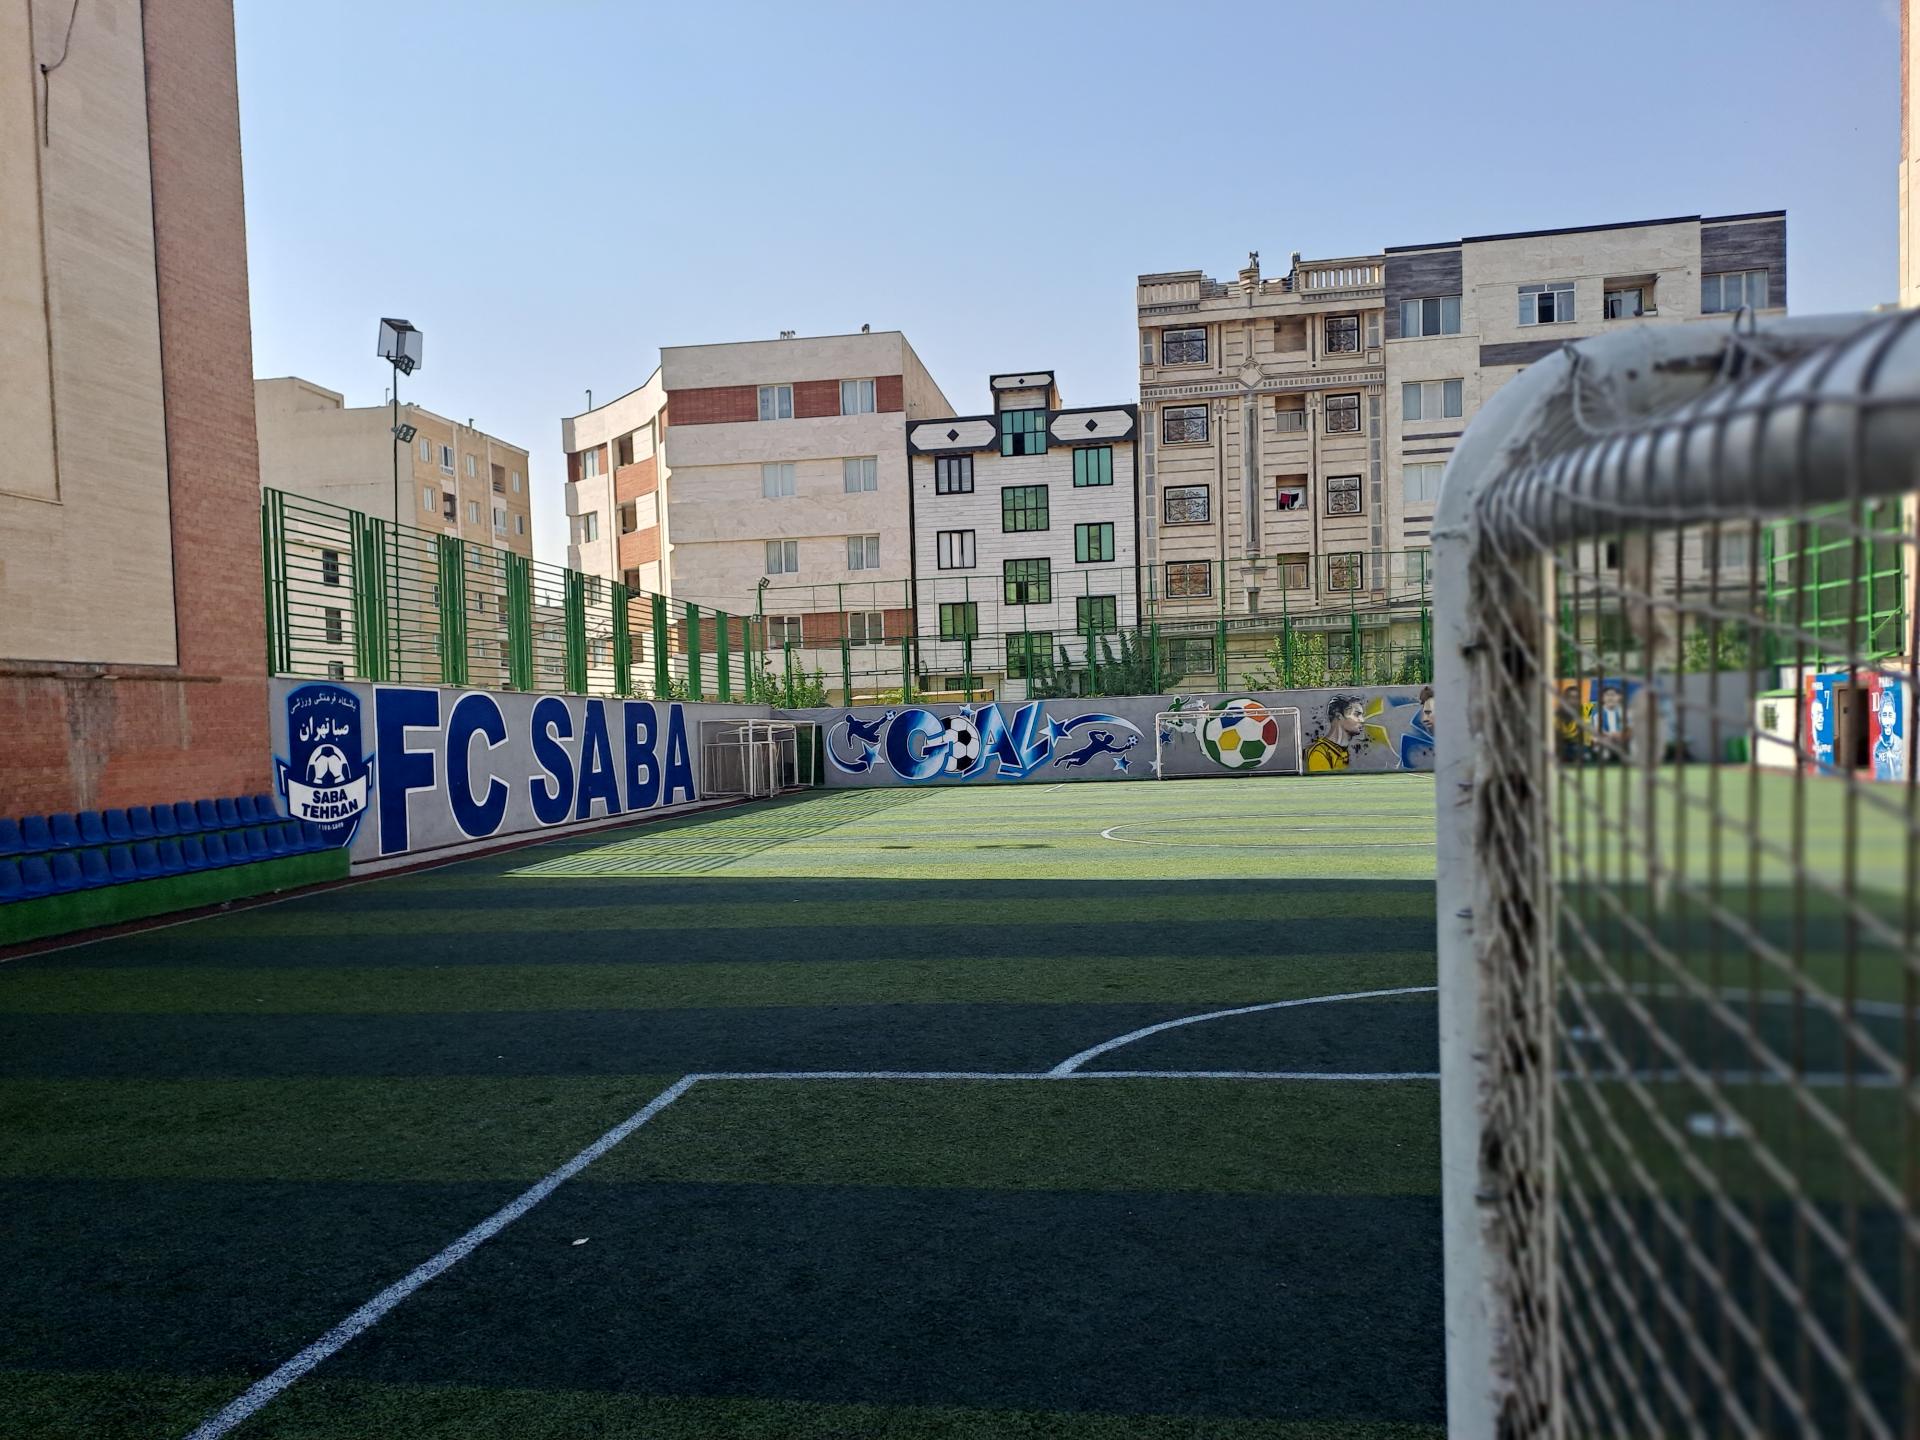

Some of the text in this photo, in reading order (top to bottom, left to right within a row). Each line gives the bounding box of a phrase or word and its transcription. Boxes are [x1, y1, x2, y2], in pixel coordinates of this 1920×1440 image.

[299, 716, 349, 742] صبا تهران
[886, 702, 1055, 780] GOAL
[373, 685, 696, 855] FC SABA
[302, 798, 358, 819] TEHRAN
[313, 789, 348, 804] SABA
